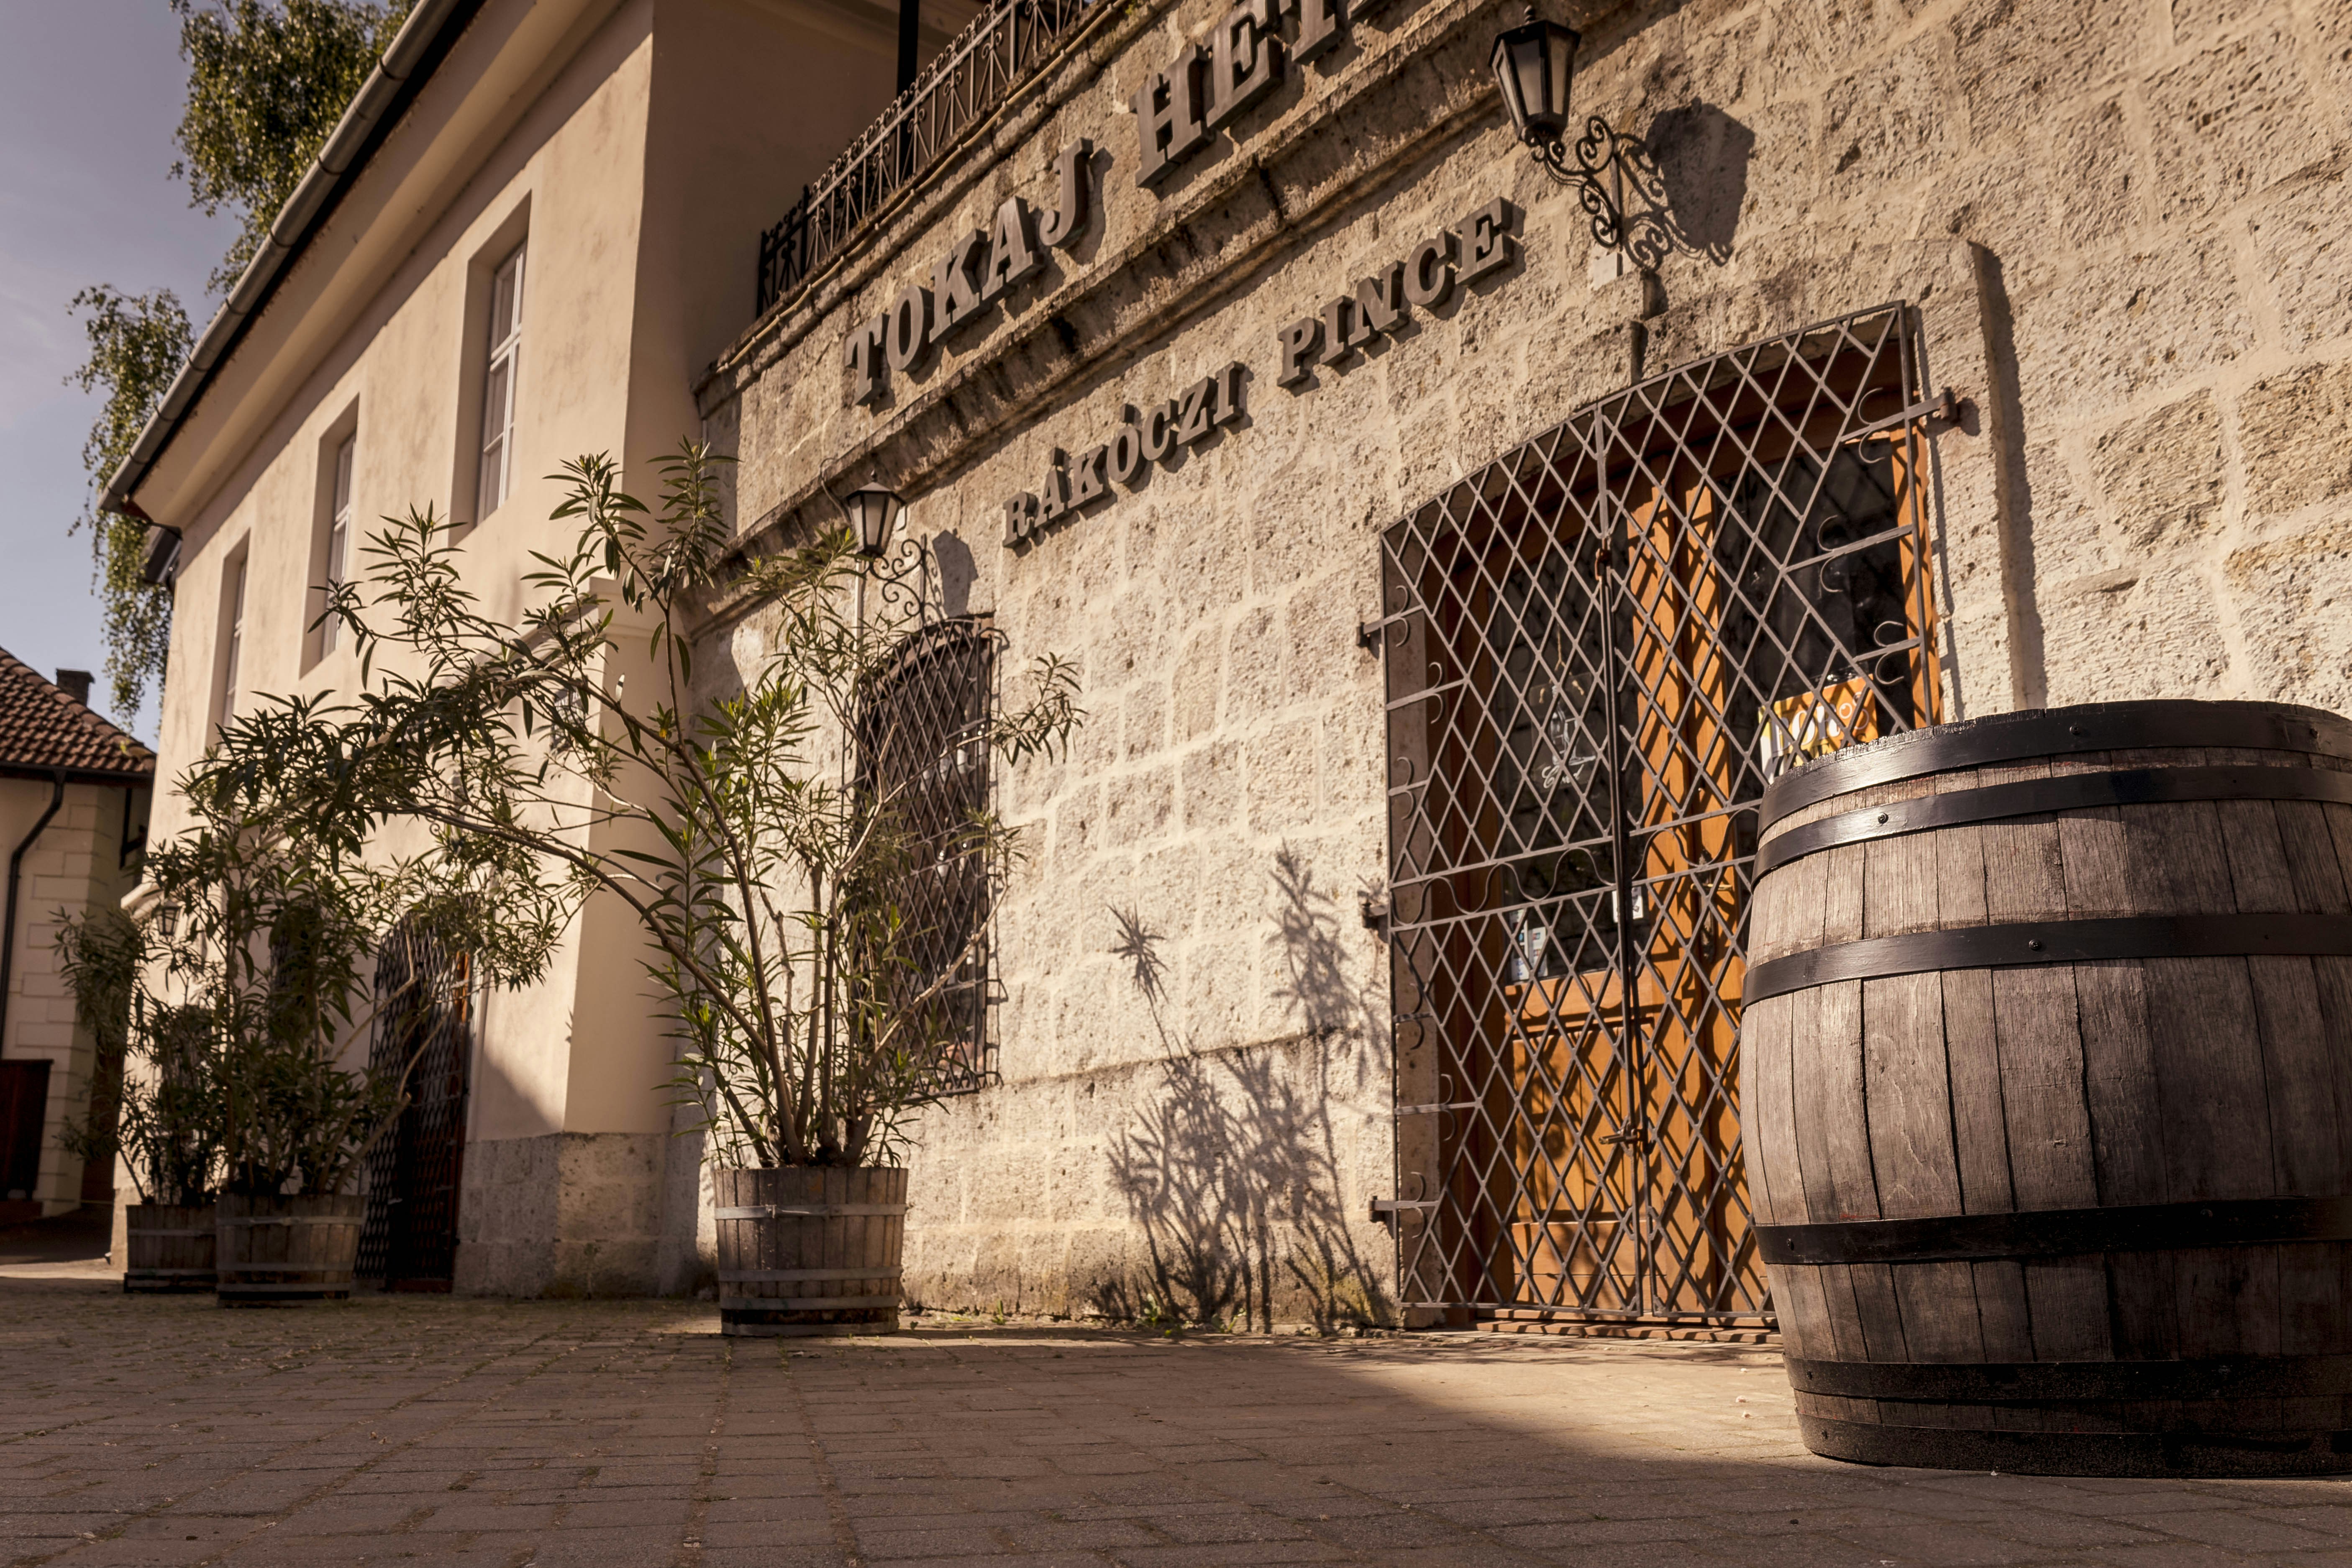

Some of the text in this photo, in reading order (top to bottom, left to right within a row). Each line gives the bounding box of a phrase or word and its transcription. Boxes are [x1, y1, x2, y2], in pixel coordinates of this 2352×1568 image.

[845, 137, 1094, 406] TOKAJ
[1002, 196, 1512, 547] RÁKÓCZI PINCE
